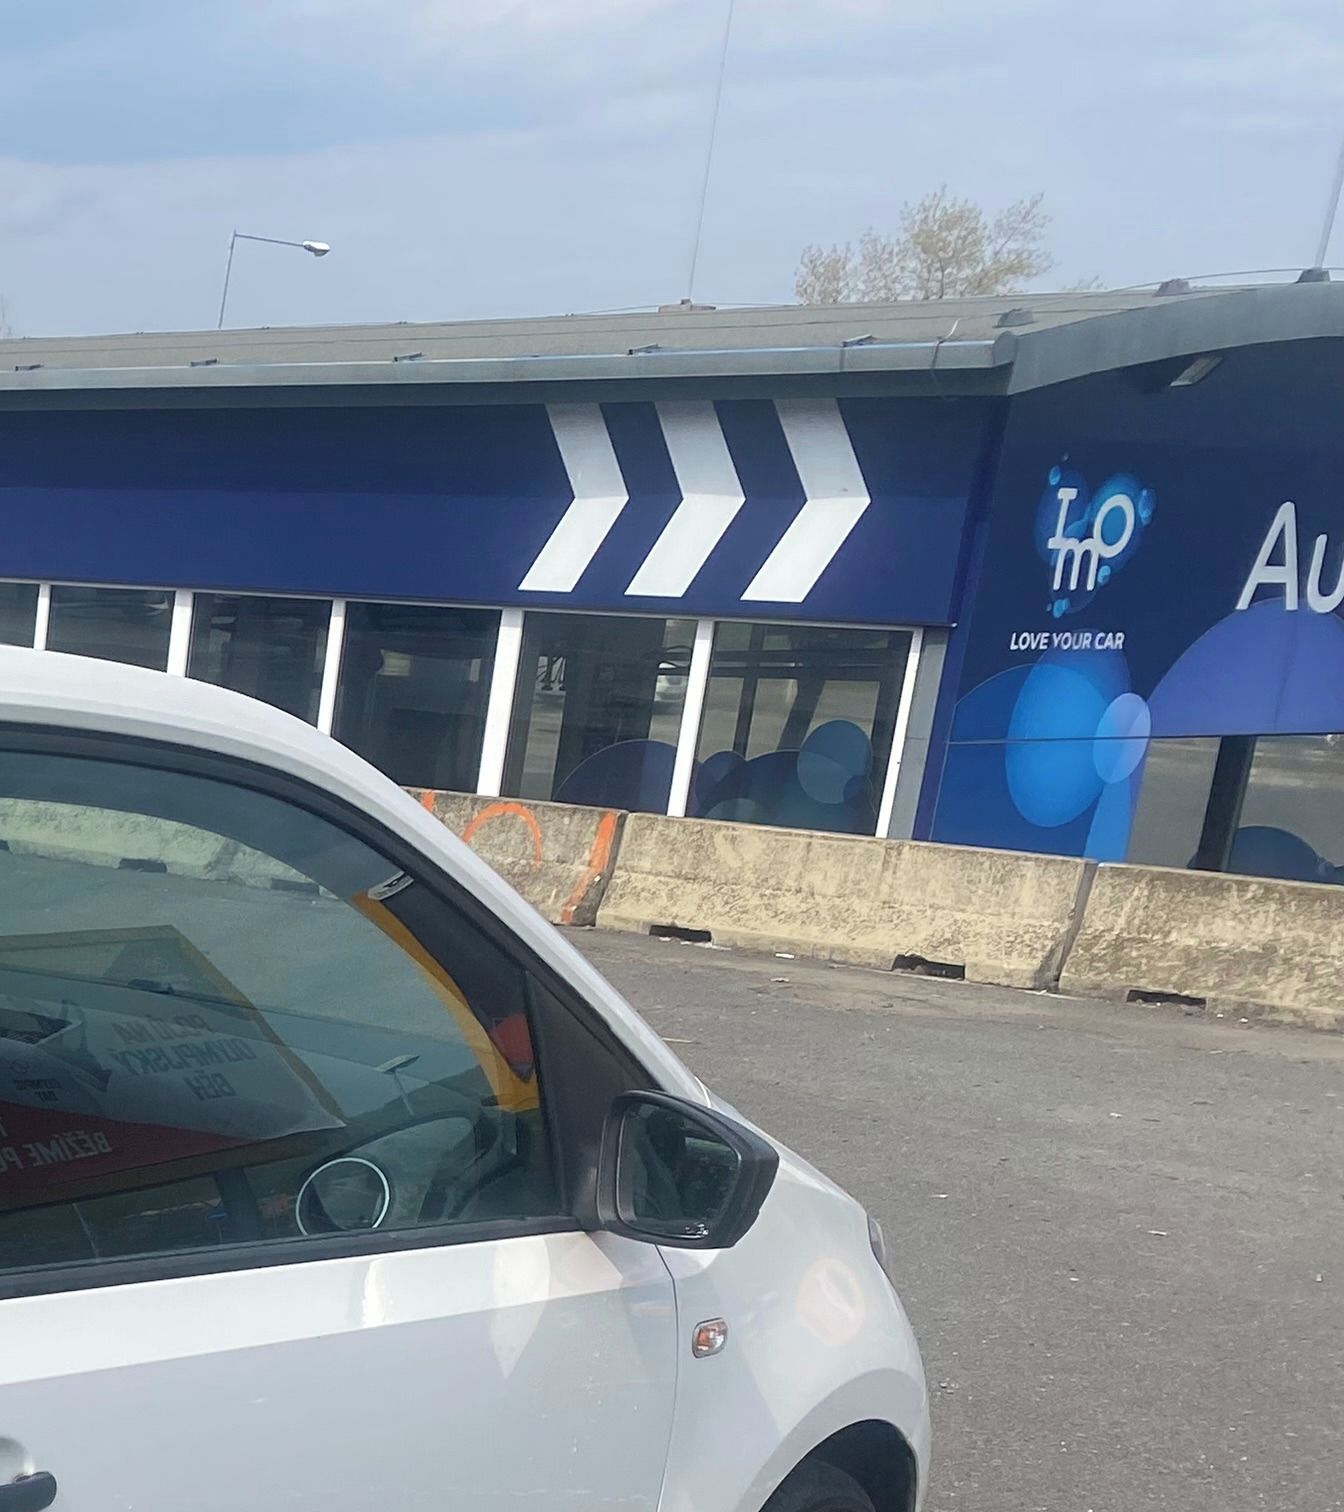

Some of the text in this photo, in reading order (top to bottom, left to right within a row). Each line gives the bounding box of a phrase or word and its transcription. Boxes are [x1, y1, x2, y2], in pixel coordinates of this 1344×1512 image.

[1010, 631, 1125, 651] LOVE YOUR CAR
